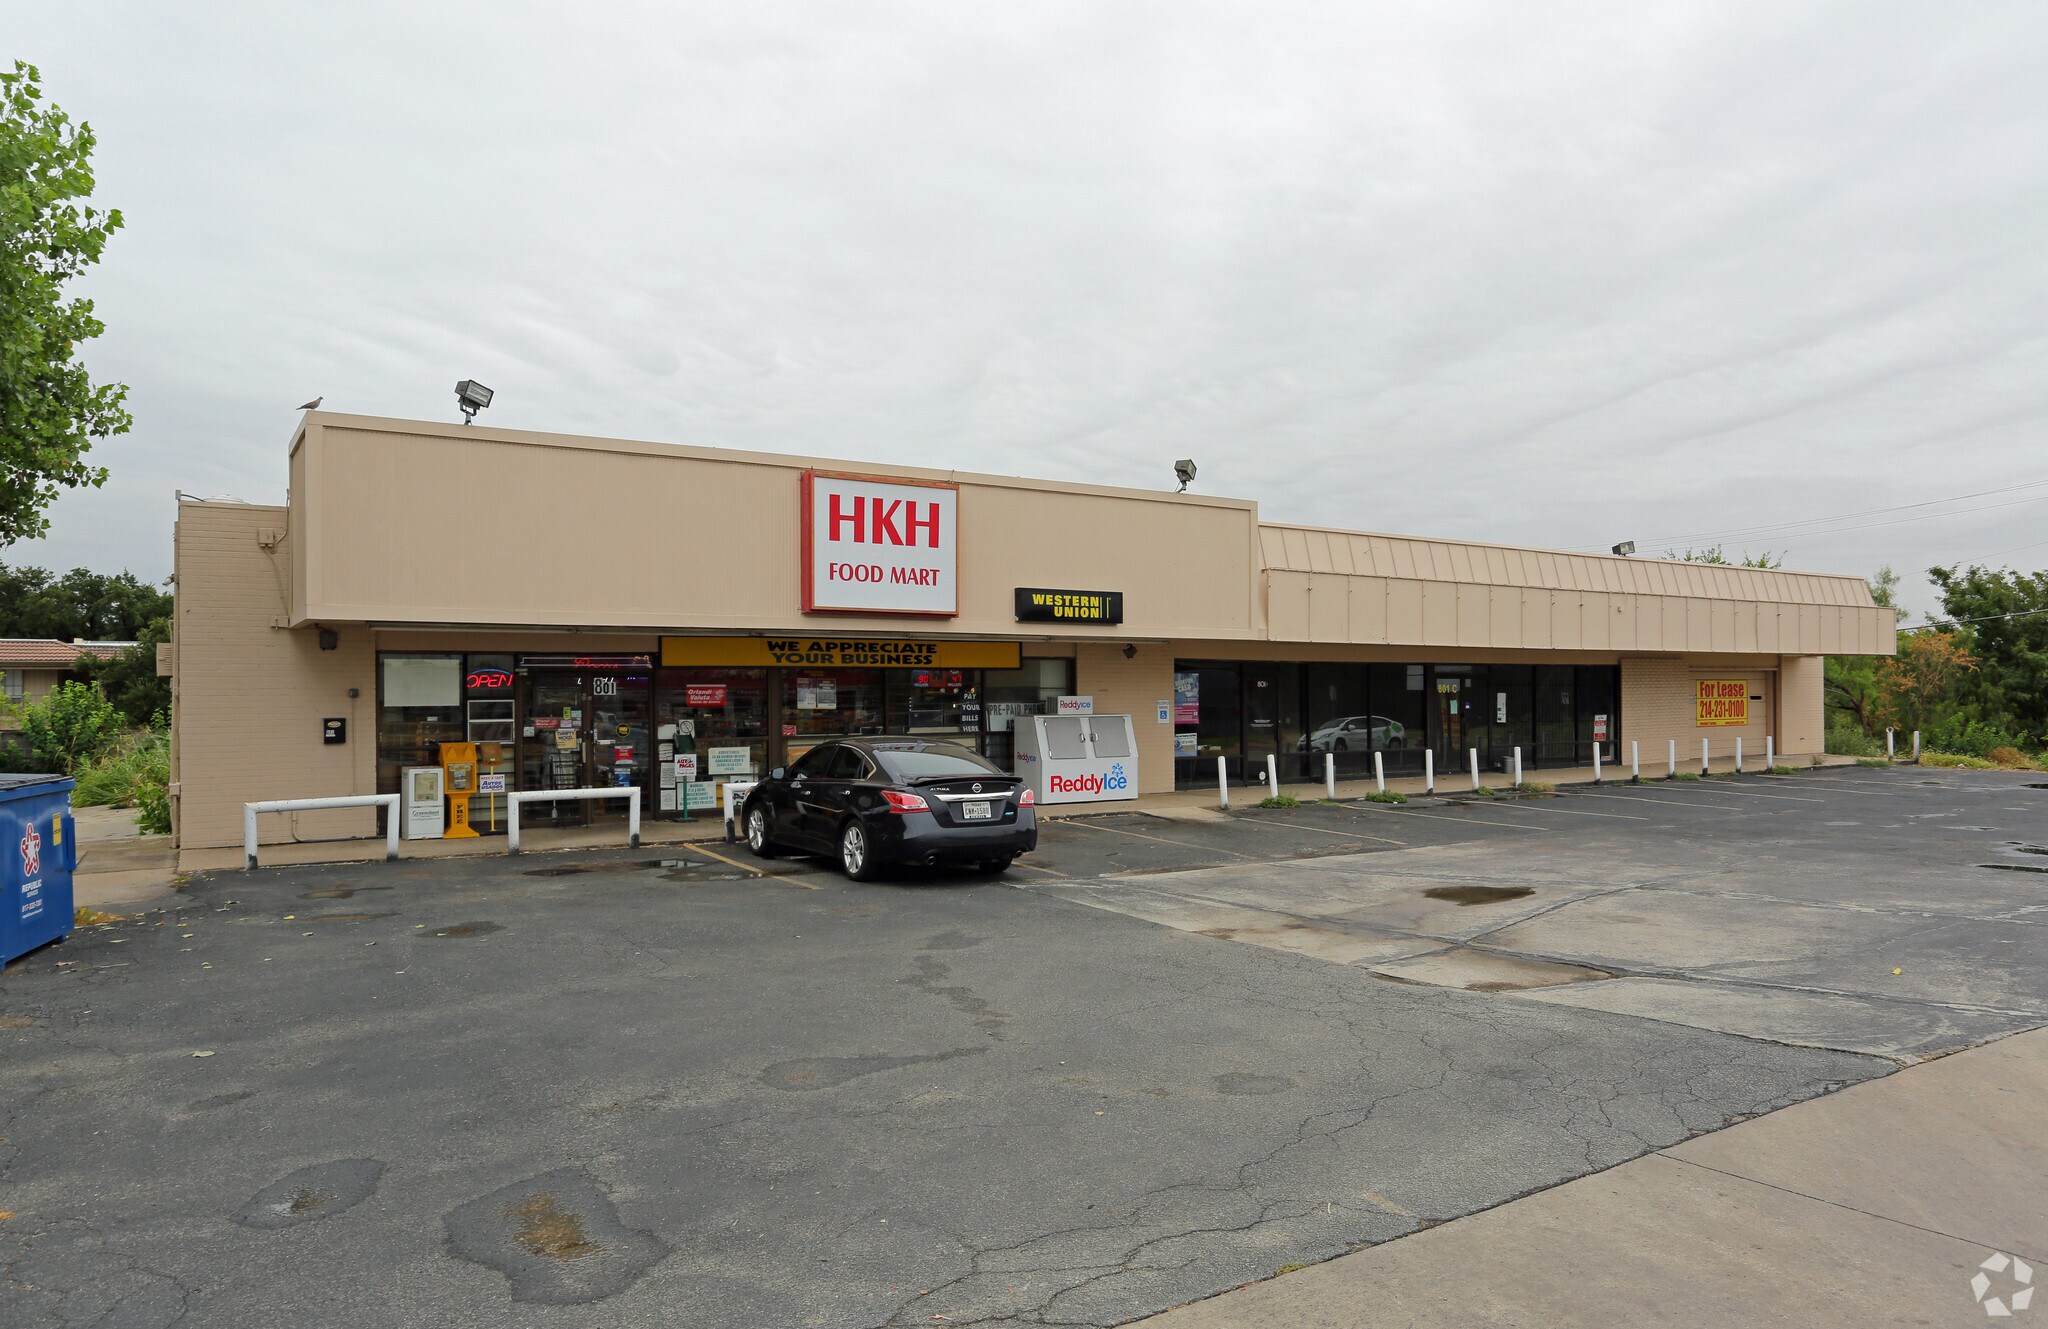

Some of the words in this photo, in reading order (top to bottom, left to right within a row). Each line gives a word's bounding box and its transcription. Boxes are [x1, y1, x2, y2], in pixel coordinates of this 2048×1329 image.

[829, 494, 940, 548] HKH
[829, 562, 884, 583] FOOD
[890, 566, 940, 586] MART
[1032, 594, 1100, 607] WESTERN
[1053, 606, 1100, 618] UNION
[766, 640, 801, 651] WE
[807, 642, 938, 654] APPRECIATE
[771, 652, 836, 664] YOUR
[841, 653, 934, 665] BUSINESS
[466, 673, 514, 688] OPEN
[594, 679, 616, 695] 801
[1700, 681, 1716, 697] For
[1717, 681, 1744, 697] Lease
[989, 704, 1021, 715] PRE-PAID
[1024, 704, 1046, 715] PHONE
[1700, 700, 1744, 718] 214-231-0100
